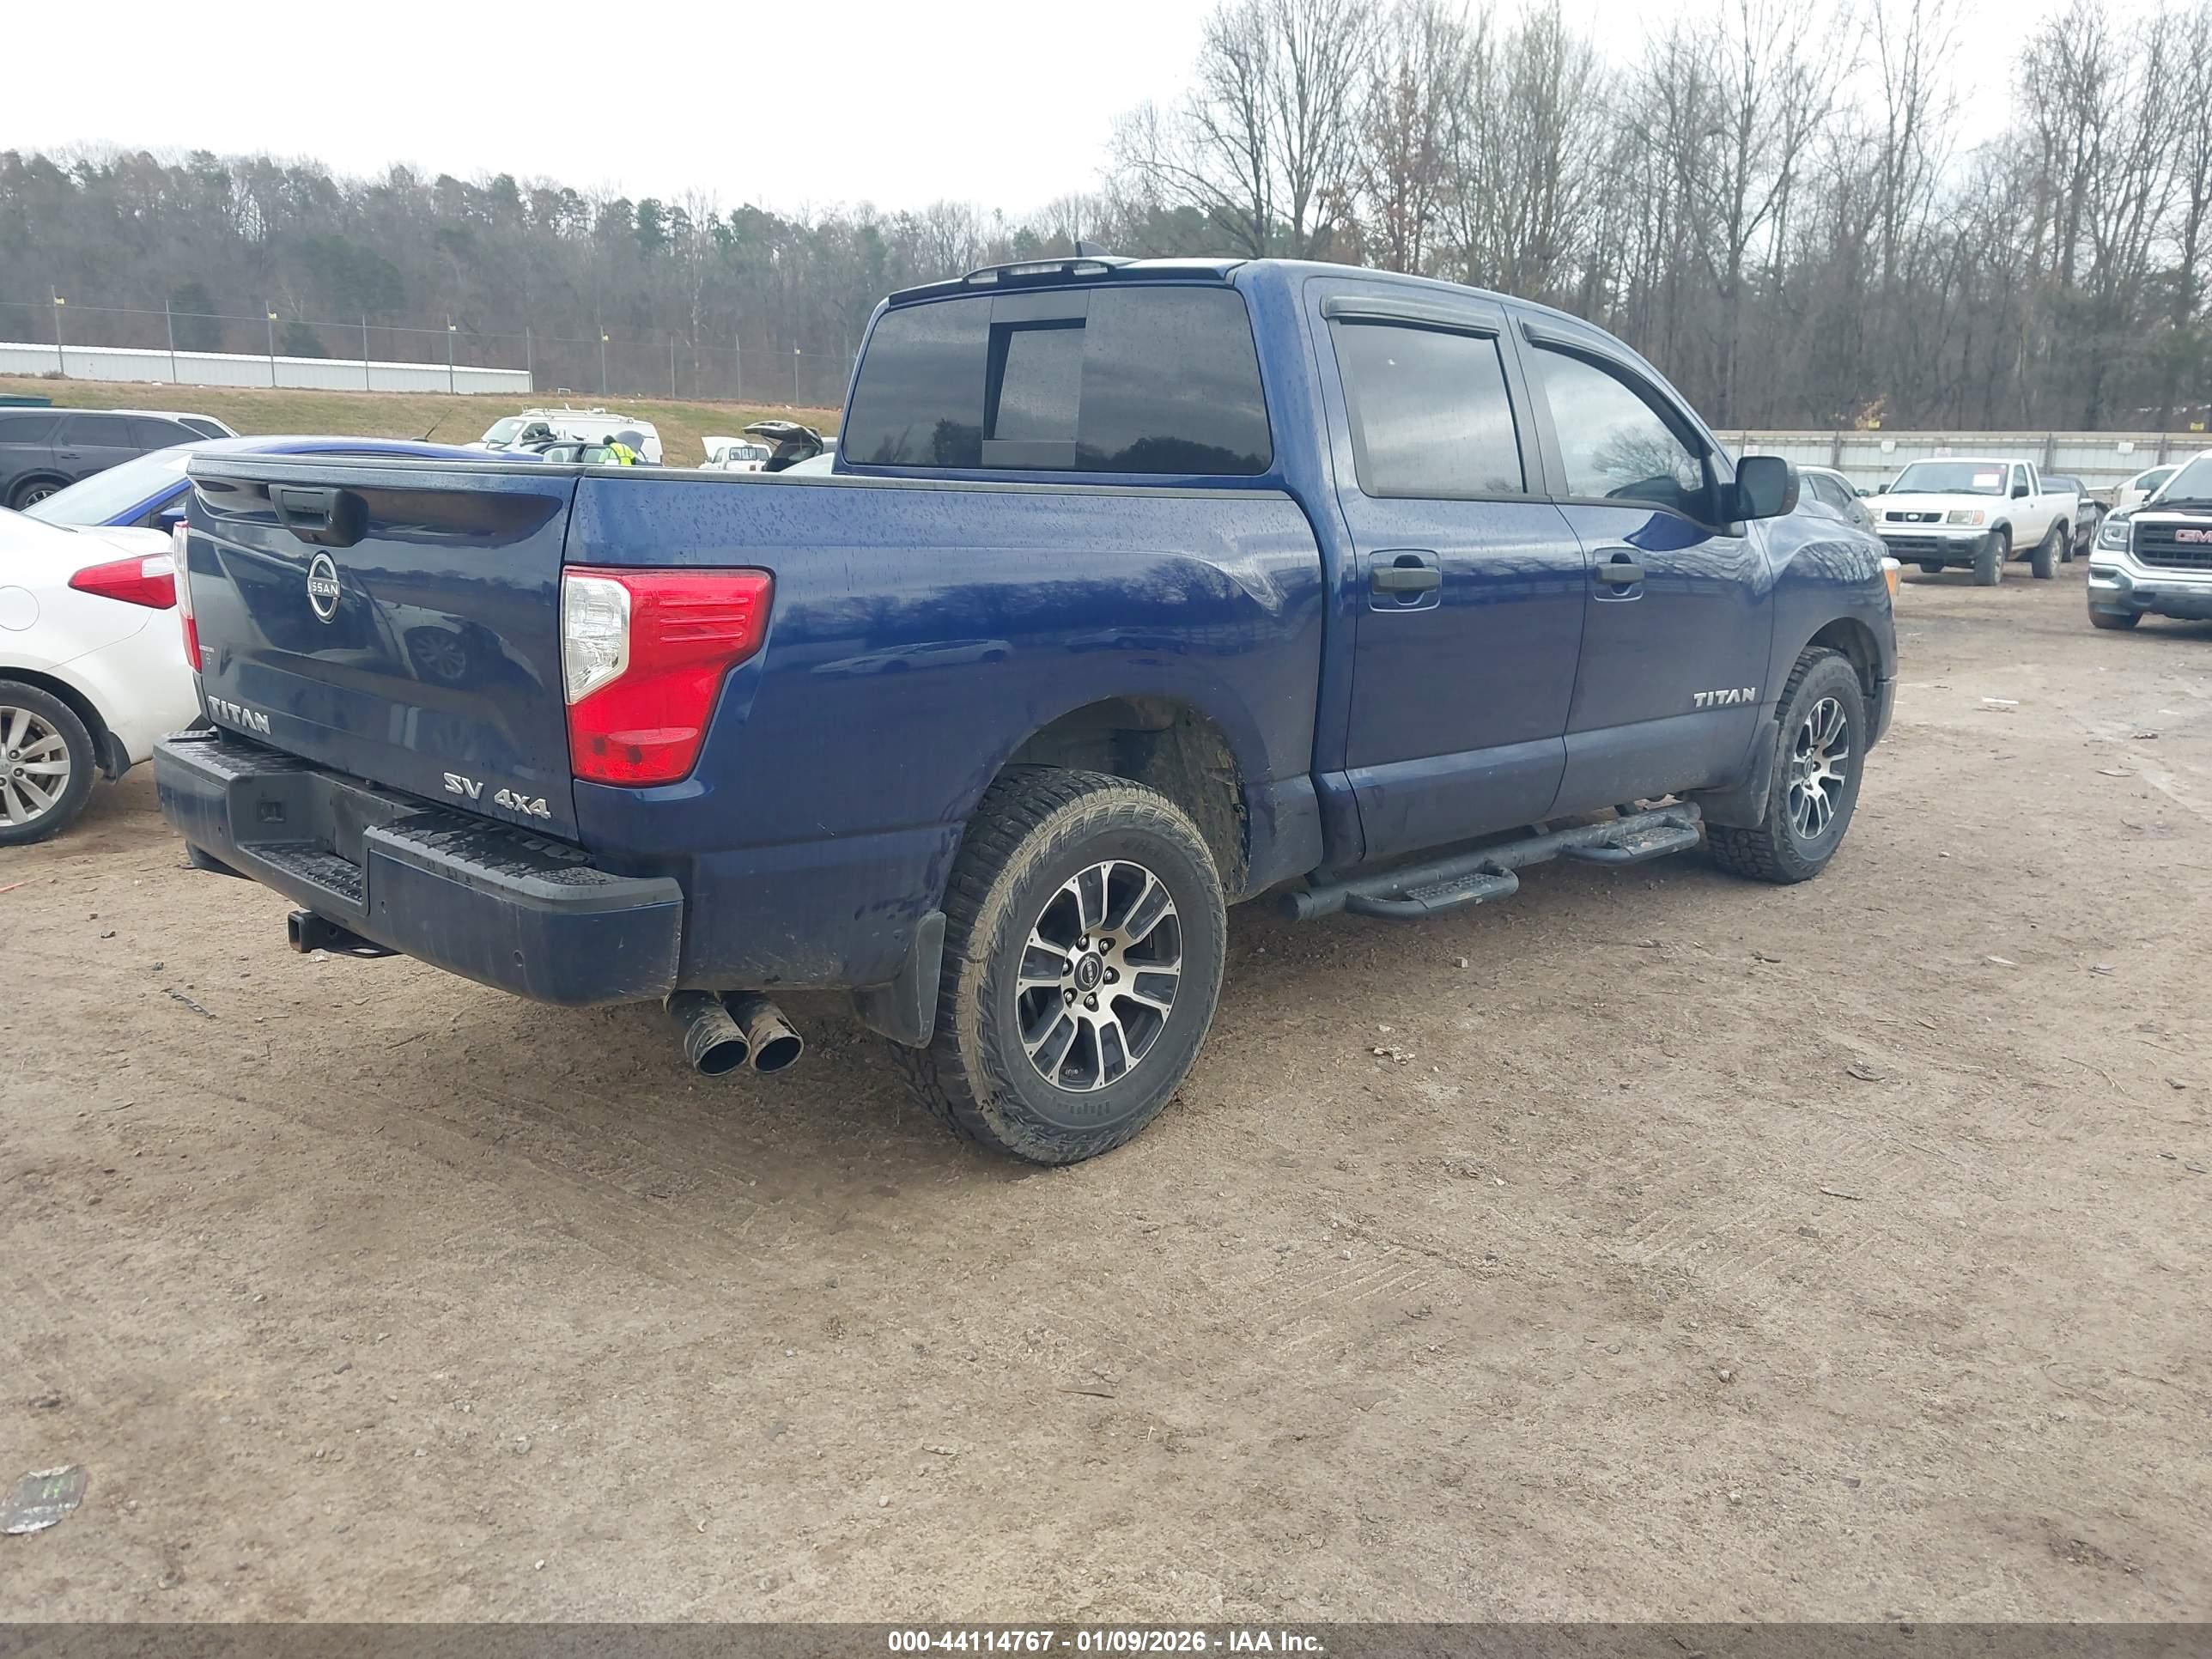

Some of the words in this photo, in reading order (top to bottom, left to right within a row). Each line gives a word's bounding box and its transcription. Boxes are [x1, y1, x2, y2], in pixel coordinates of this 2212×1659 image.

[310, 580, 338, 595] SSAN
[1693, 687, 1755, 708] TITAN
[208, 695, 271, 736] TITAN
[443, 772, 483, 799] SV
